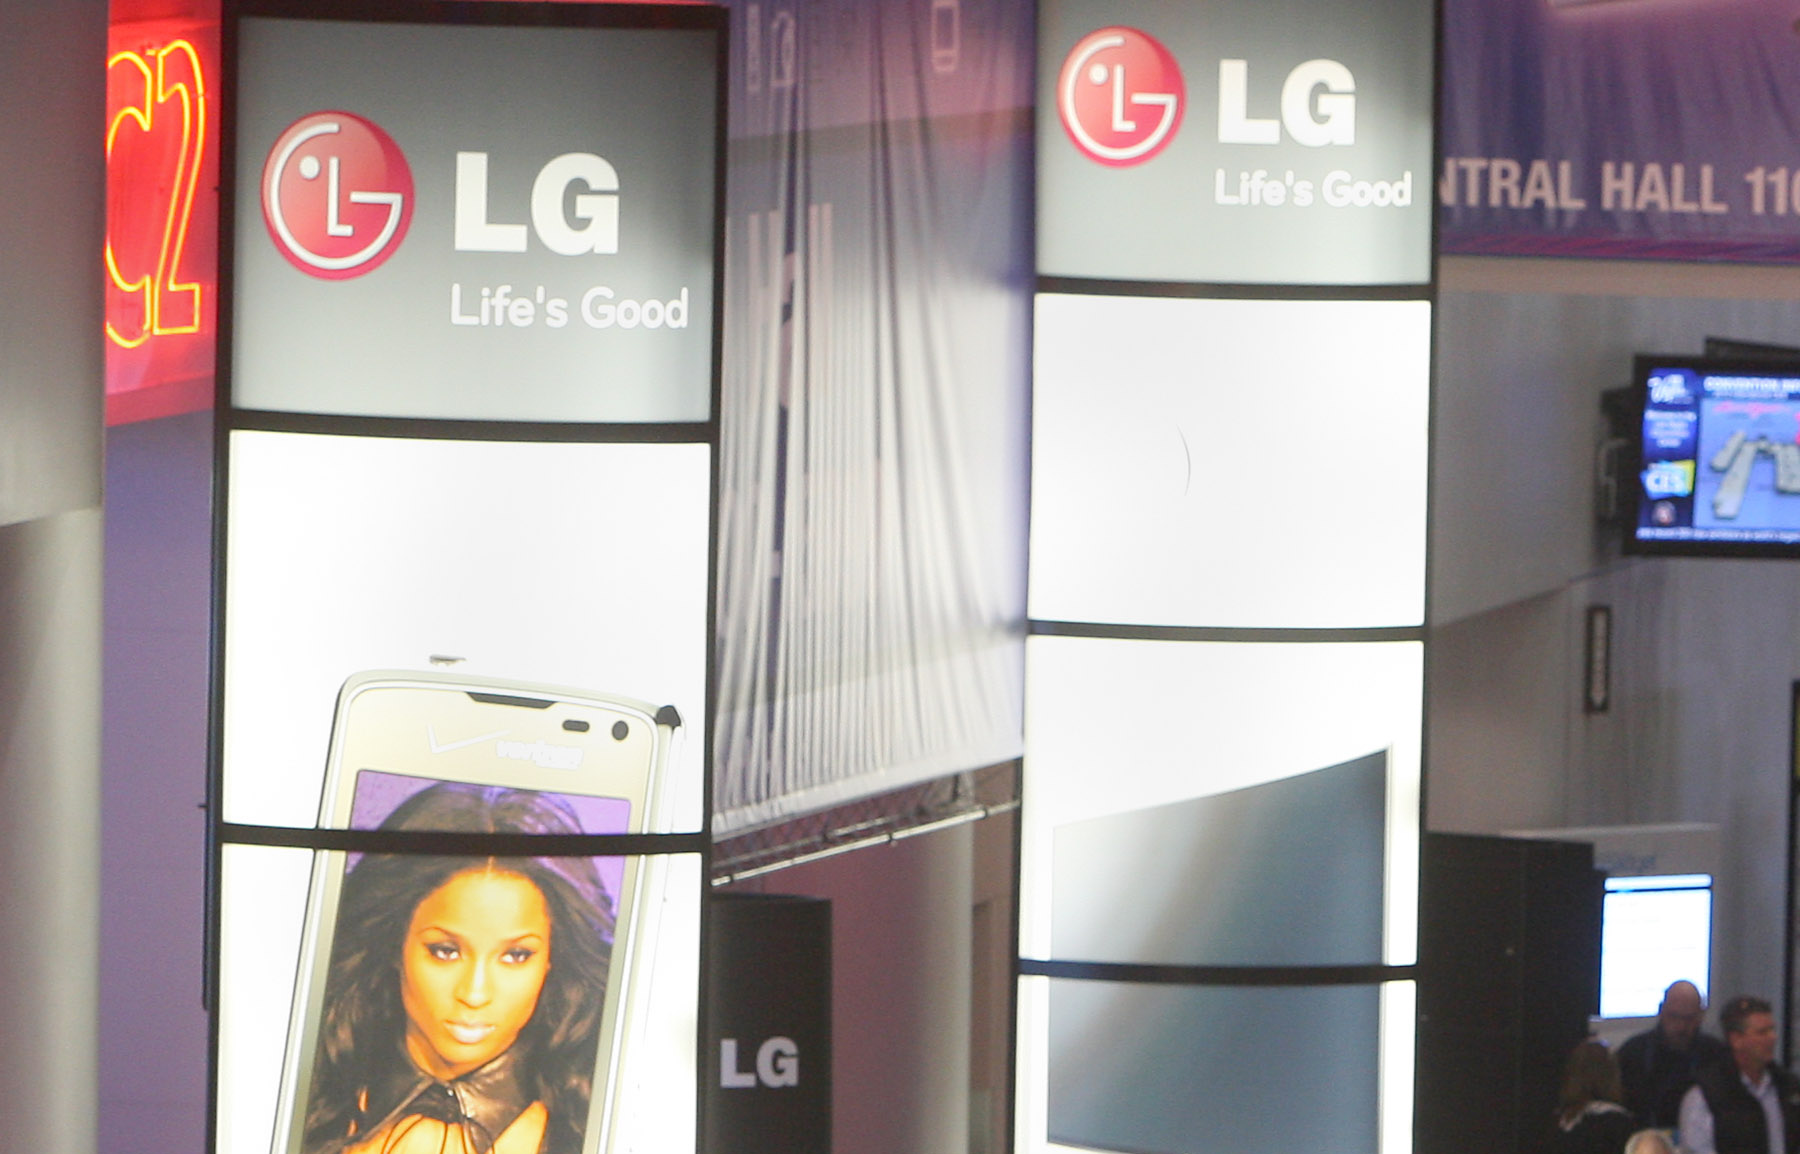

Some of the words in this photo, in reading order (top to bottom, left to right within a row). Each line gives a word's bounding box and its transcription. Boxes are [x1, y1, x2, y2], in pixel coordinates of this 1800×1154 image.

[1218, 59, 1356, 147] LG
[455, 151, 620, 256] LG
[1215, 168, 1313, 207] Life's
[1322, 170, 1413, 209] Good
[1601, 162, 1728, 214] HALL
[450, 284, 569, 329] Life's
[581, 285, 689, 331] Good
[719, 1036, 800, 1089] LG
